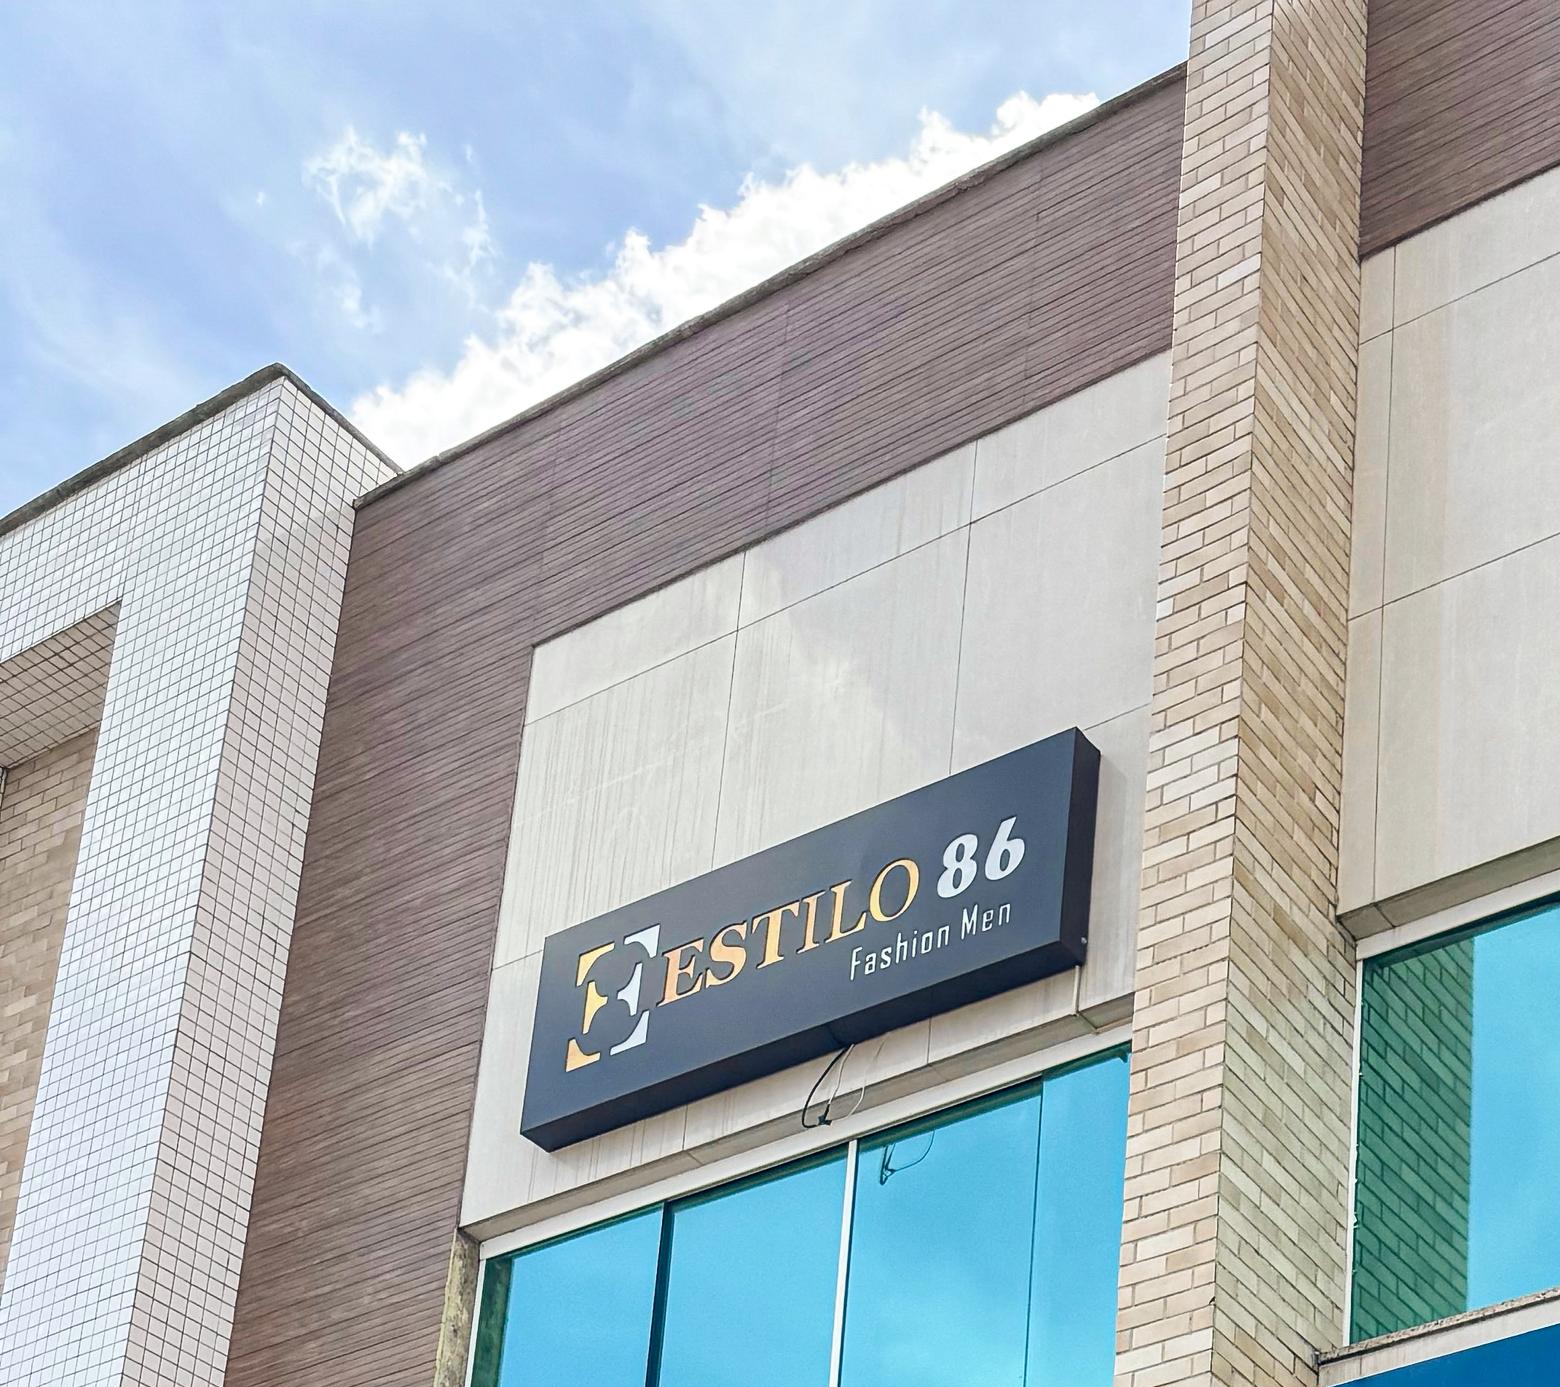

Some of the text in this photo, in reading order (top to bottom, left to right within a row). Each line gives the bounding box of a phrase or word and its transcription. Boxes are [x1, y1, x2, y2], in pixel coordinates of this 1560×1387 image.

[656, 817, 1026, 1008] ESTILO 86
[849, 903, 1012, 981] Fashion Men
